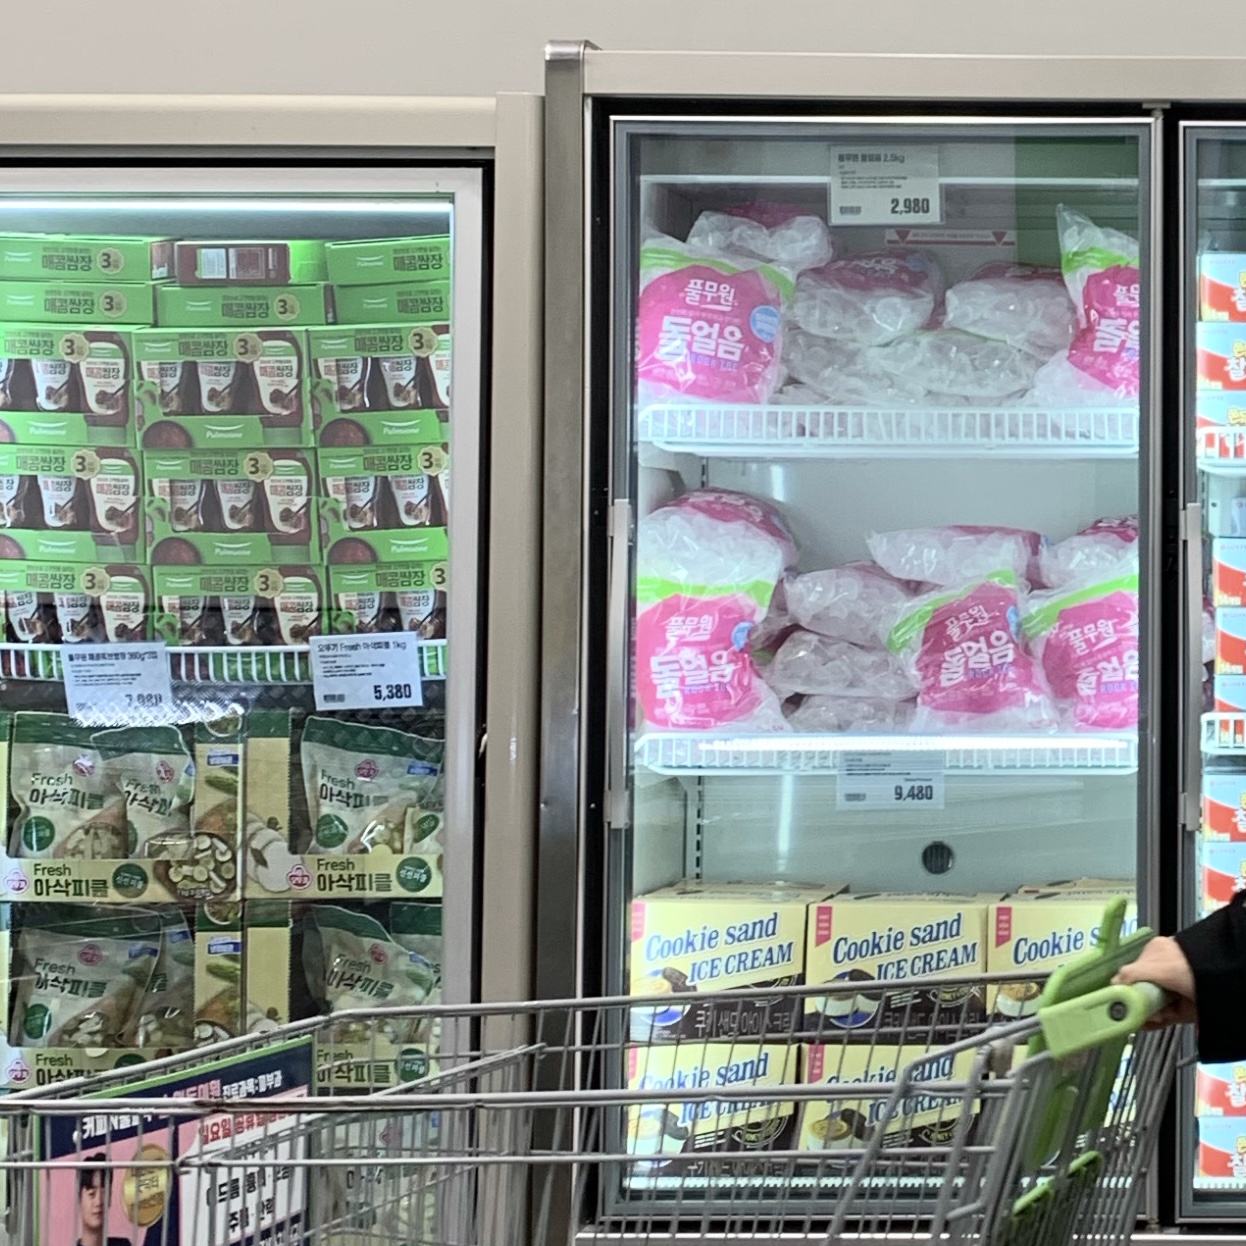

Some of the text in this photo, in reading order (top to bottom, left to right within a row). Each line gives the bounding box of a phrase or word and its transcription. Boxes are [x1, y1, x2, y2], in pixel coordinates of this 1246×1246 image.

[890, 198, 930, 214] 2,980
[684, 279, 735, 311] 풀무원
[665, 614, 713, 642] 풀무원
[1068, 619, 1117, 655] 풀무원
[373, 684, 412, 701] 5,380
[321, 769, 355, 790] Fresh
[894, 785, 933, 800] 9,480
[34, 863, 71, 877] Fresh
[317, 858, 355, 871] Fresh
[34, 878, 109, 897] 아삭피클
[317, 873, 393, 892] 아삭피클
[646, 911, 778, 961] Cookie sand
[833, 912, 962, 964] Cookie sand
[1013, 927, 1083, 965] Cookie
[35, 958, 75, 975] Fresh
[337, 954, 372, 973] Fresh
[688, 942, 794, 983] ICE CREAM
[877, 942, 978, 982] ICE CREAM
[36, 1054, 73, 1066] Fresh
[715, 1052, 769, 1086] sand
